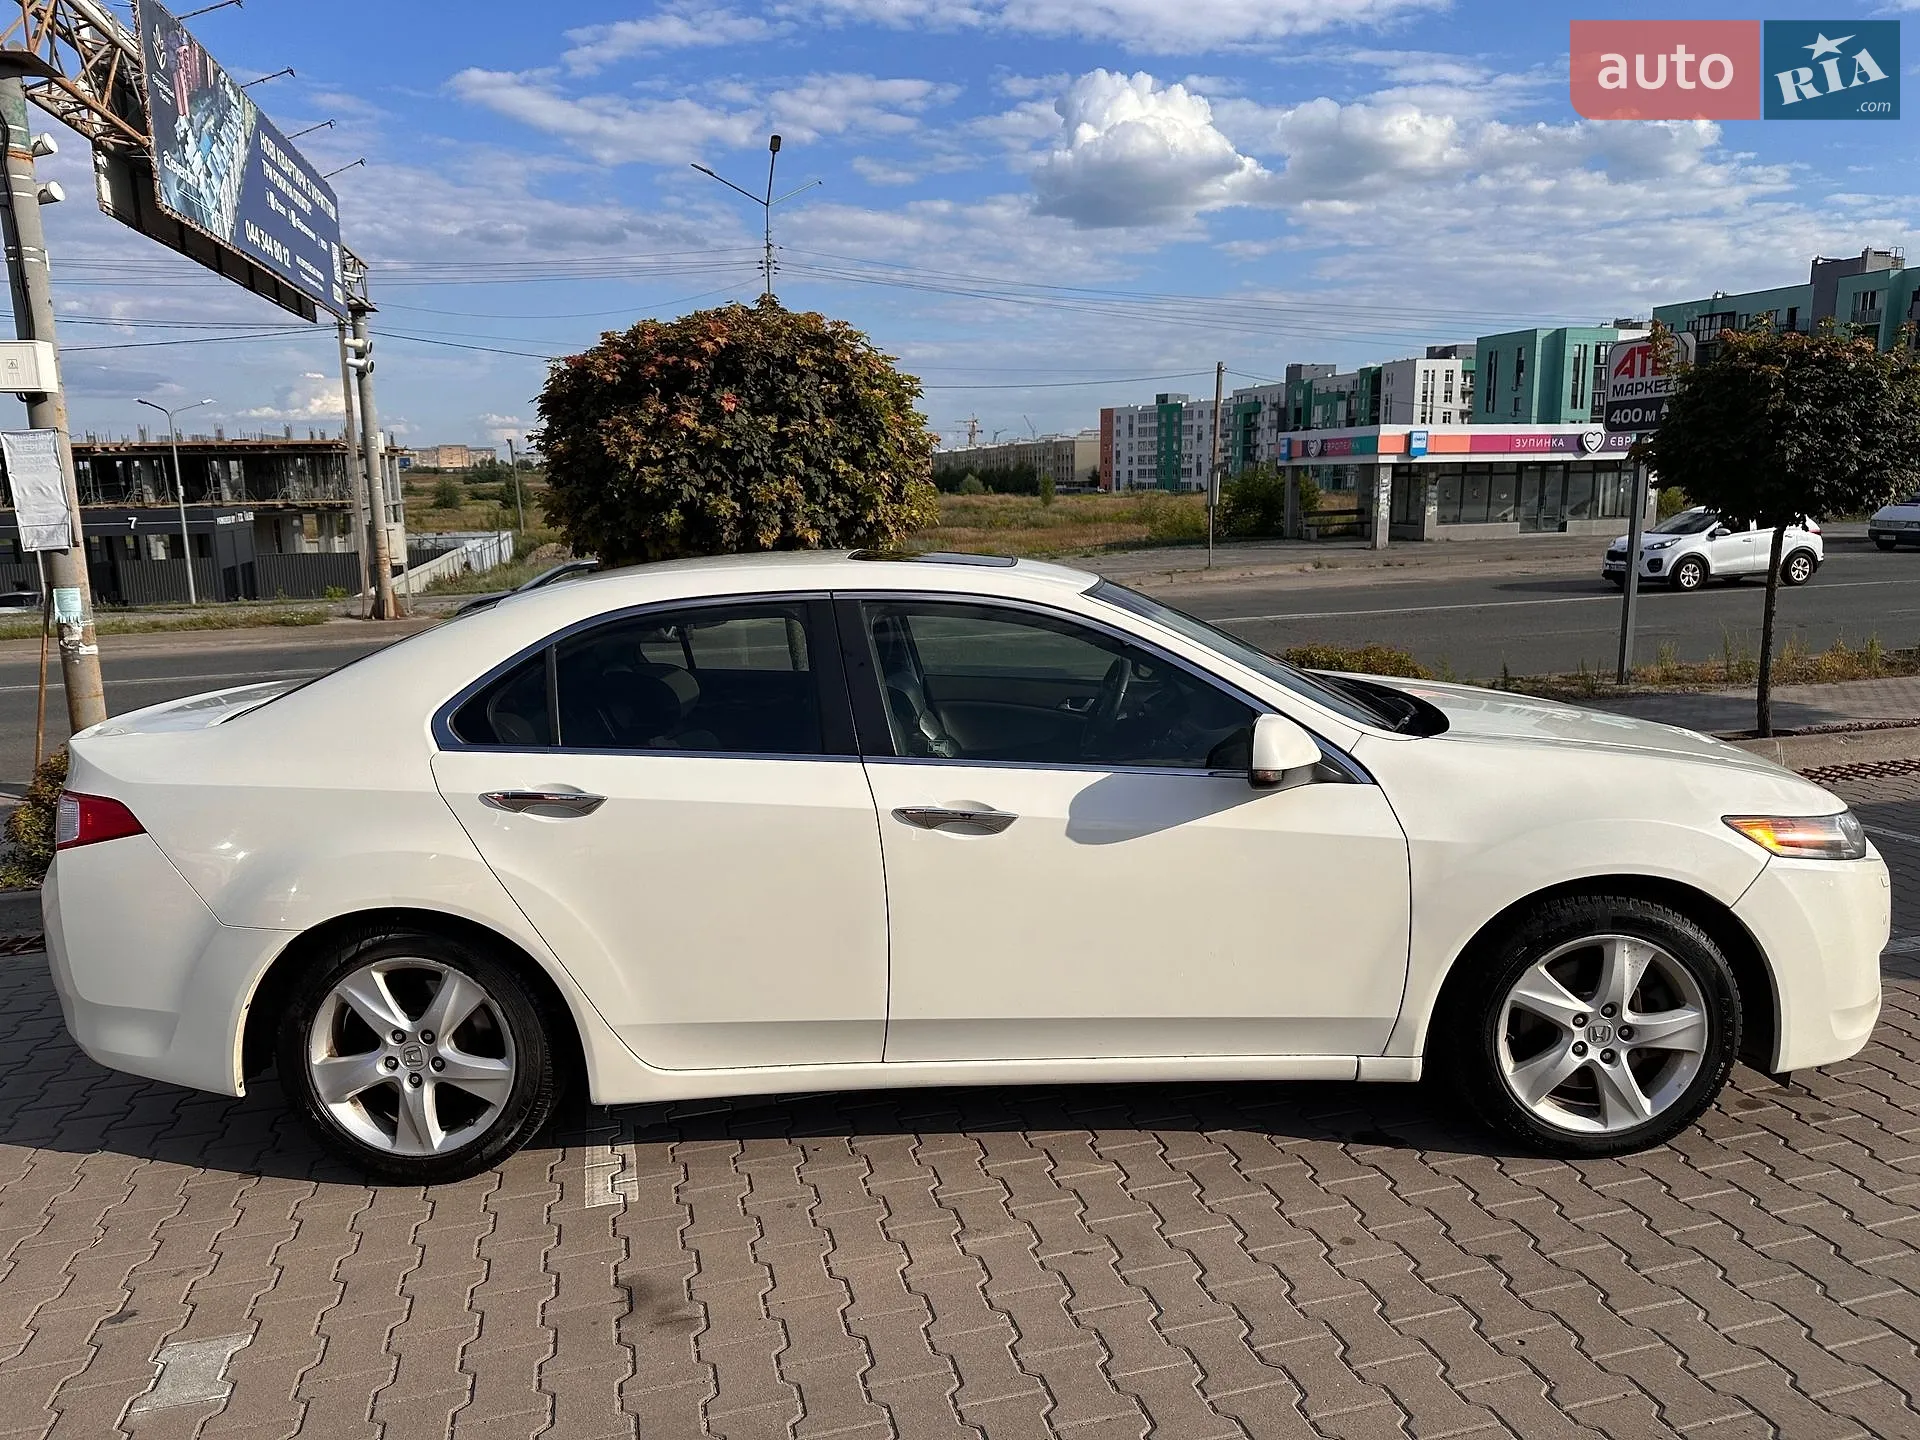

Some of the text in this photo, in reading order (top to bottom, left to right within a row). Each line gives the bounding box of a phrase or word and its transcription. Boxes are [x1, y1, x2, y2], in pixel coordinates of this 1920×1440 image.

[245, 219, 261, 249] 044
[260, 229, 275, 258] 344
[1610, 408, 1643, 425] 400
[1515, 436, 1635, 448] ЗУПИНКА ЄВР
[128, 516, 137, 530] 7
